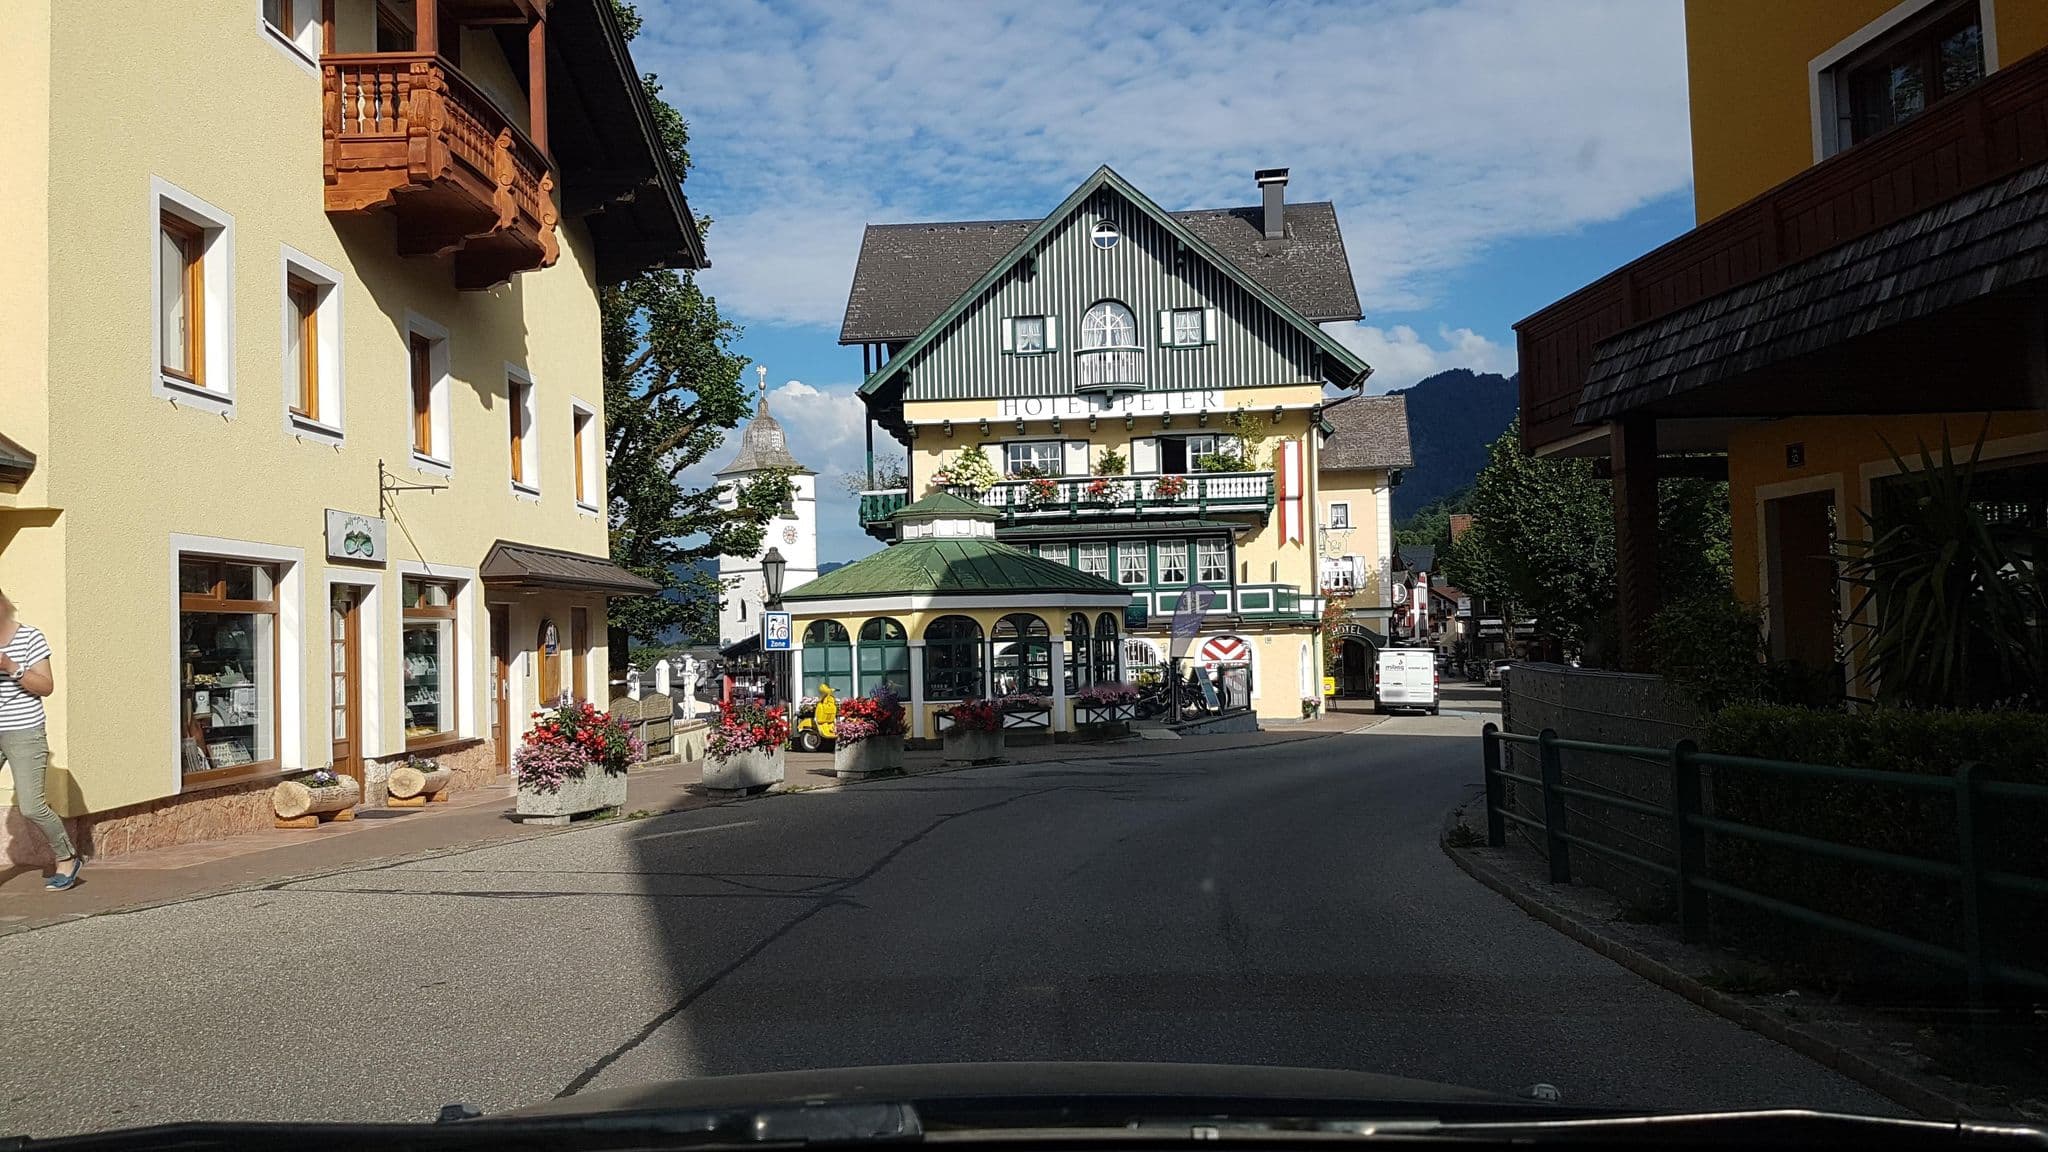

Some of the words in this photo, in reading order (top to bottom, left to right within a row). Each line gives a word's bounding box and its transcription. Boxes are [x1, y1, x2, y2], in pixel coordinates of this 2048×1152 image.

[1003, 395, 1099, 416] HOTEL
[1122, 390, 1217, 411] PETER
[770, 640, 786, 648] Zone
